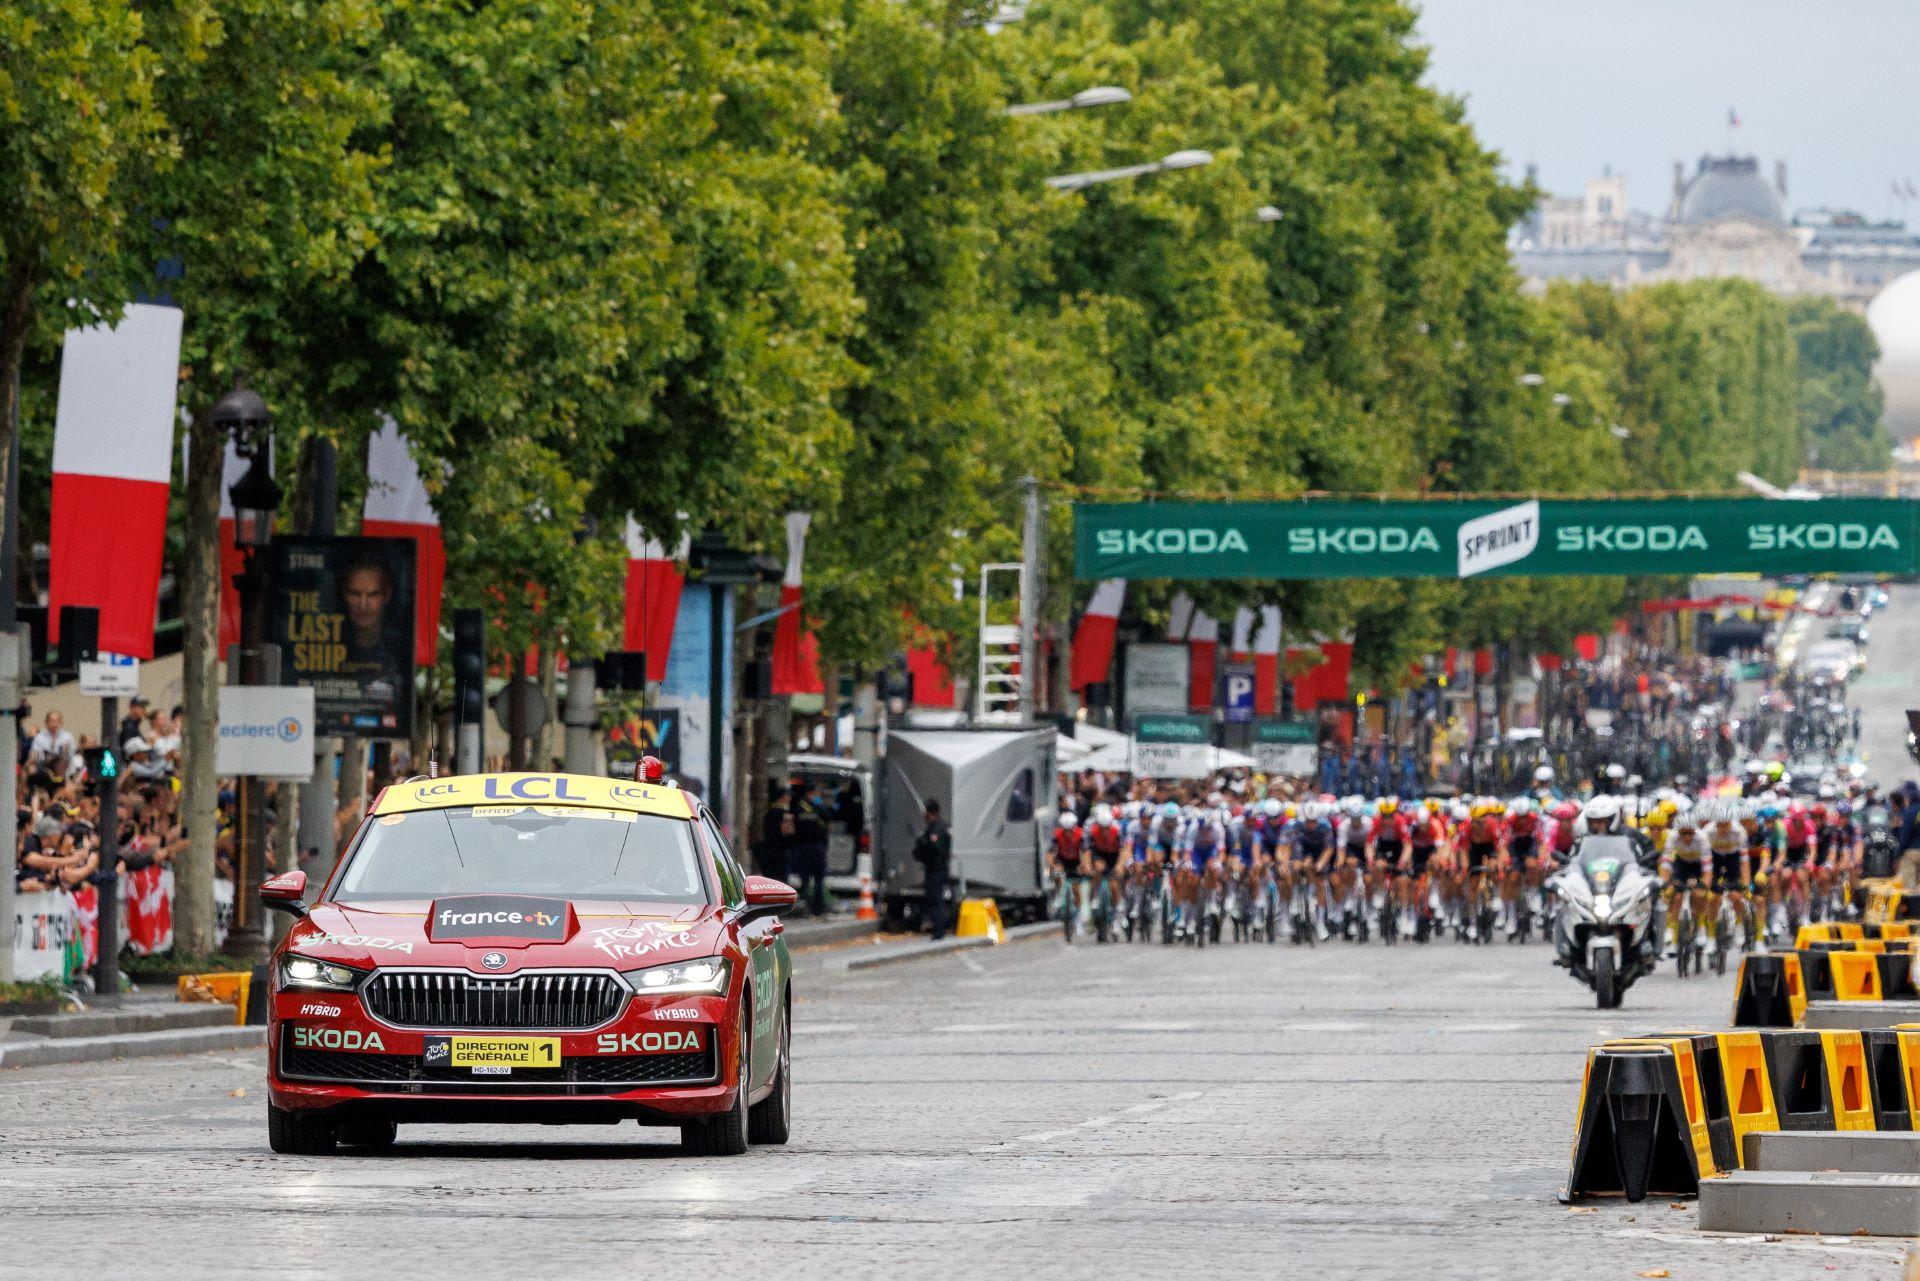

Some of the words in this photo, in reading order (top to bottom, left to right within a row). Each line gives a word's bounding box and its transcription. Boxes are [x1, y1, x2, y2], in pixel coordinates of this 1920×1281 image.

[1096, 528, 1249, 554] SKODA
[1288, 527, 1441, 554] SKODA
[1464, 519, 1532, 561] SPRINT
[1556, 525, 1708, 551] SKODA
[1748, 523, 1899, 550] SKODA
[289, 591, 320, 612] THE
[288, 613, 346, 641] LAST
[294, 642, 347, 672] SHIP
[1227, 676, 1253, 706] P
[219, 725, 276, 738] eclerc
[419, 783, 460, 797] LCL
[484, 777, 587, 801] LCL
[613, 785, 657, 800] LCL
[475, 807, 518, 815] OFFICIEL
[608, 811, 617, 819] 1
[300, 1003, 342, 1018] HYBRID
[653, 1008, 699, 1020] HYBRID
[294, 1027, 386, 1052] SKODA
[597, 1030, 700, 1053] SKODA
[456, 1042, 529, 1051] DIRECTION
[538, 1043, 553, 1062] 1
[456, 1050, 529, 1062] GÉNÉRALE
